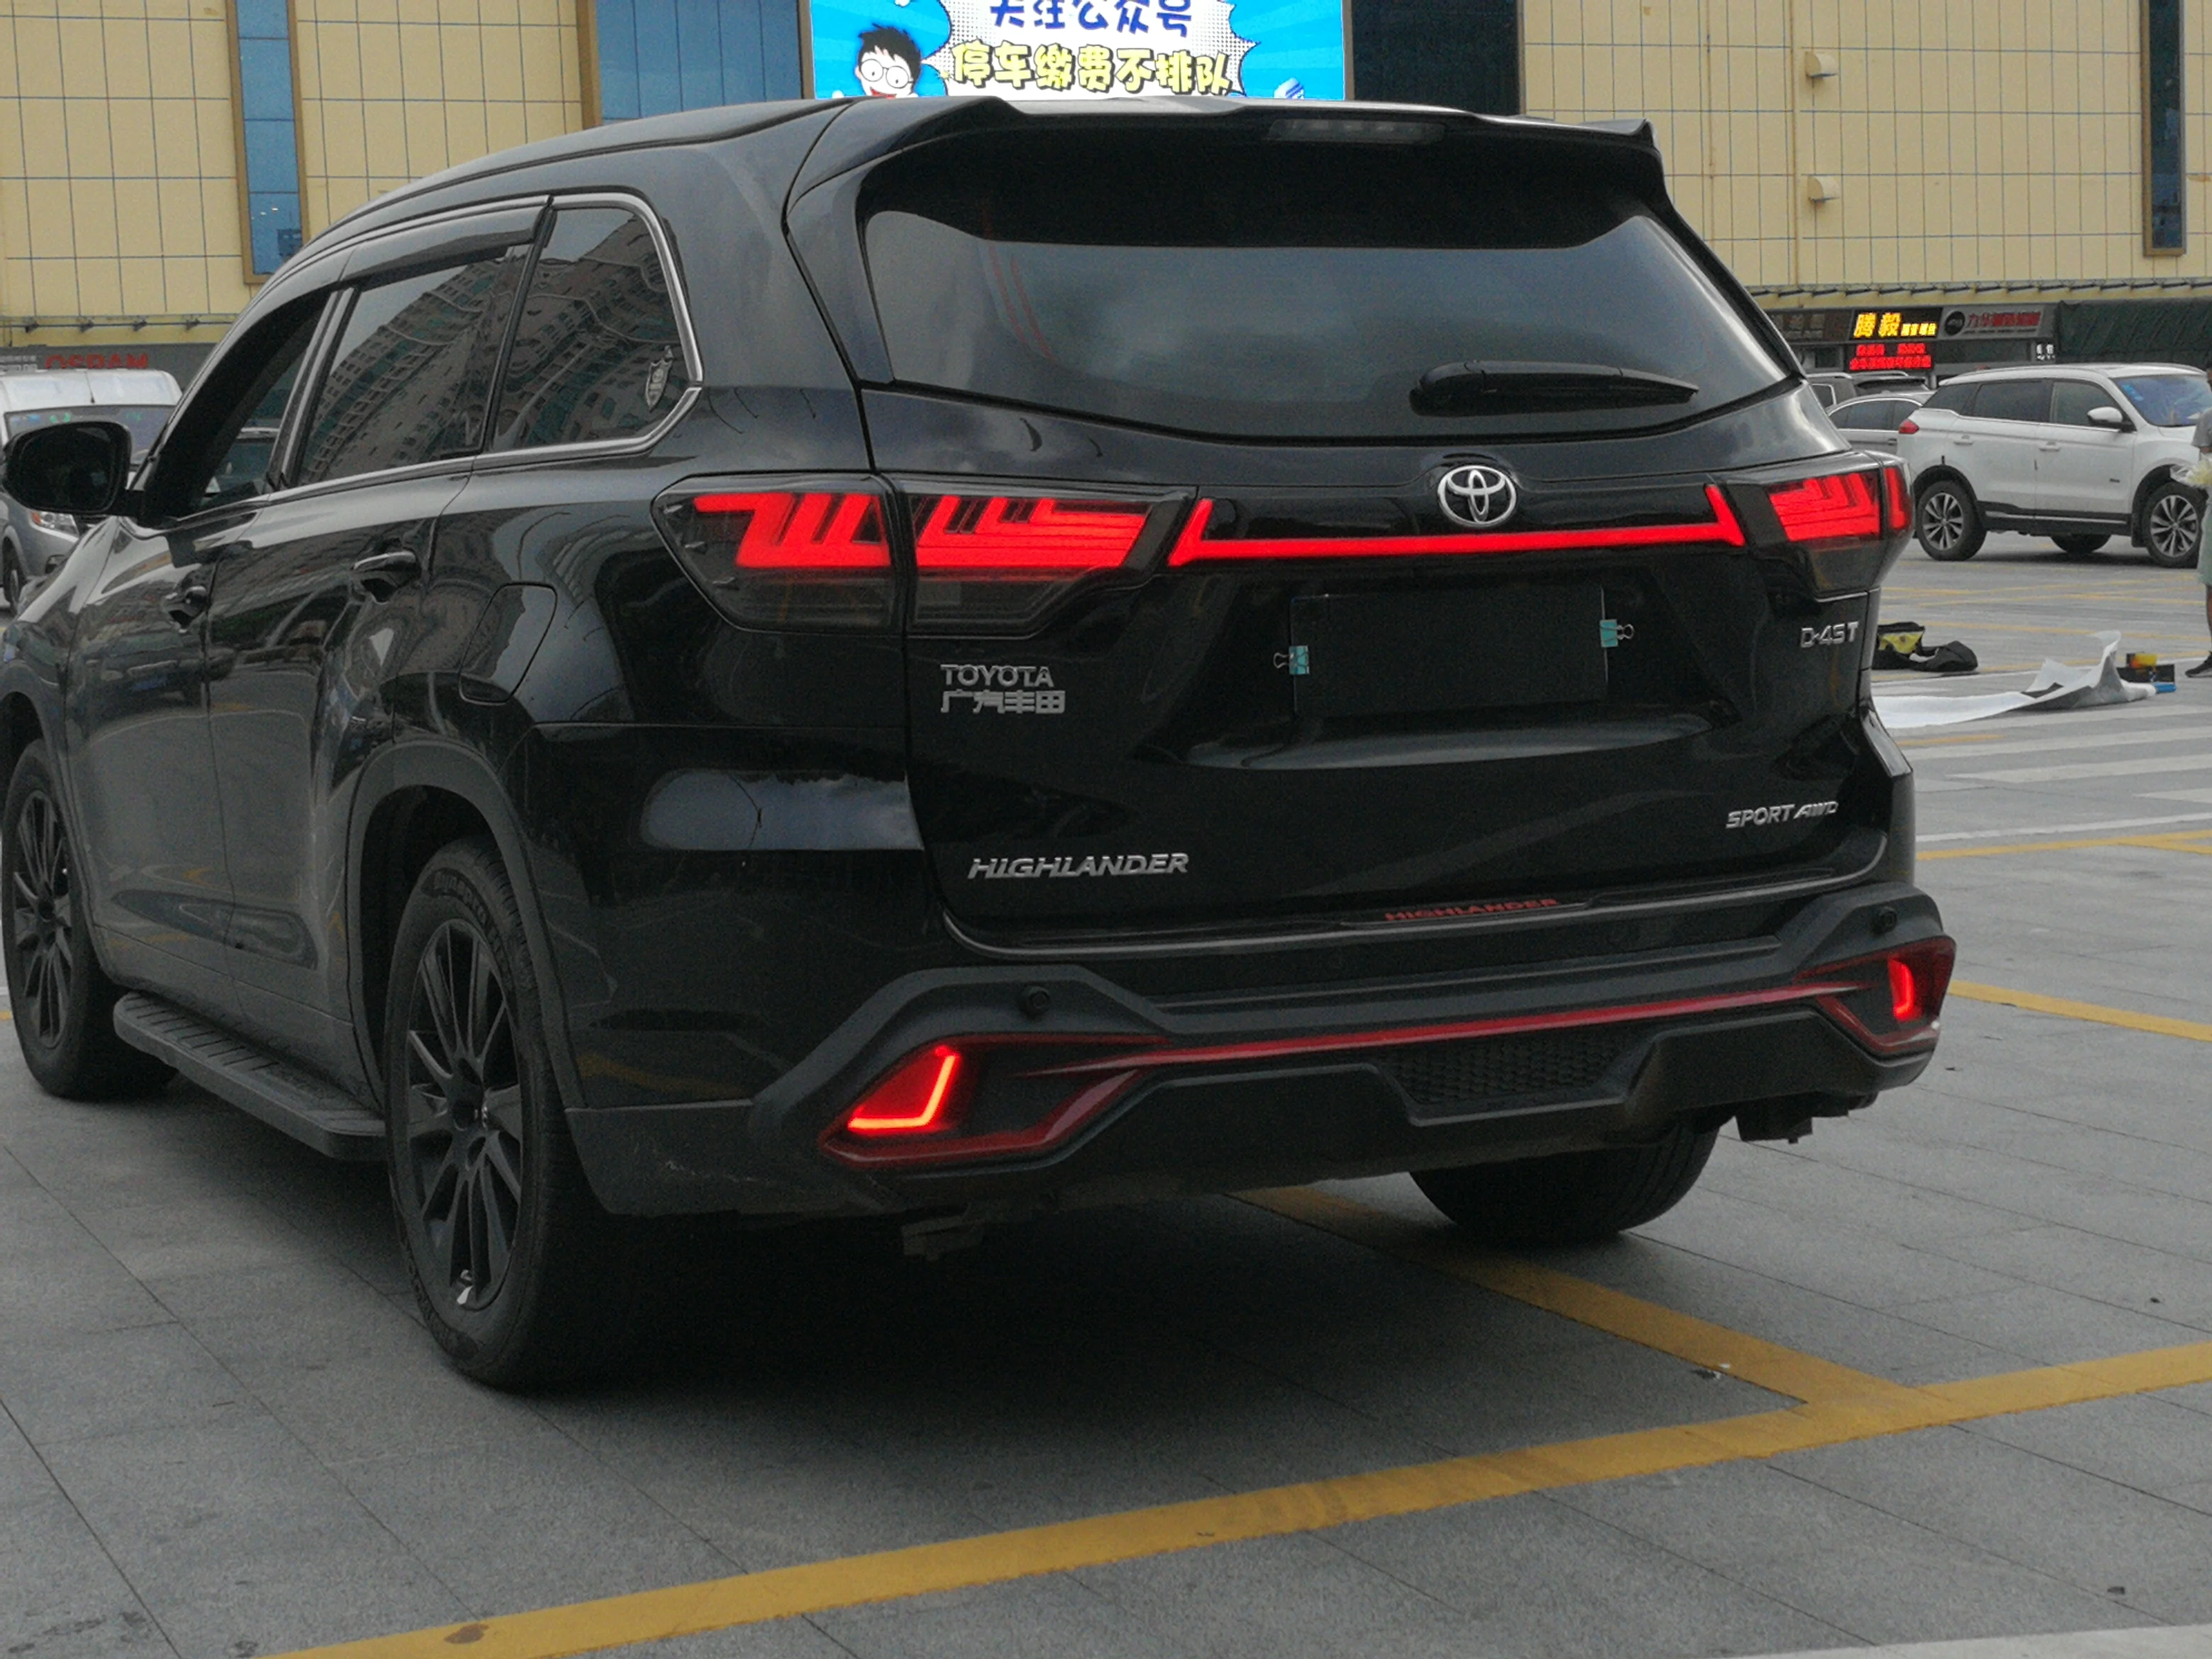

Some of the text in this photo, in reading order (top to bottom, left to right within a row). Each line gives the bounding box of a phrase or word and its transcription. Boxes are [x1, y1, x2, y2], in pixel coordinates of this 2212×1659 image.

[951, 38, 1233, 96] 停车缴费不排队
[940, 664, 1054, 687] TOYOTA
[940, 689, 1066, 714] 广汽丰田
[1726, 801, 1839, 829] SPORT AWD
[967, 853, 1189, 879] HIGHLANDER
